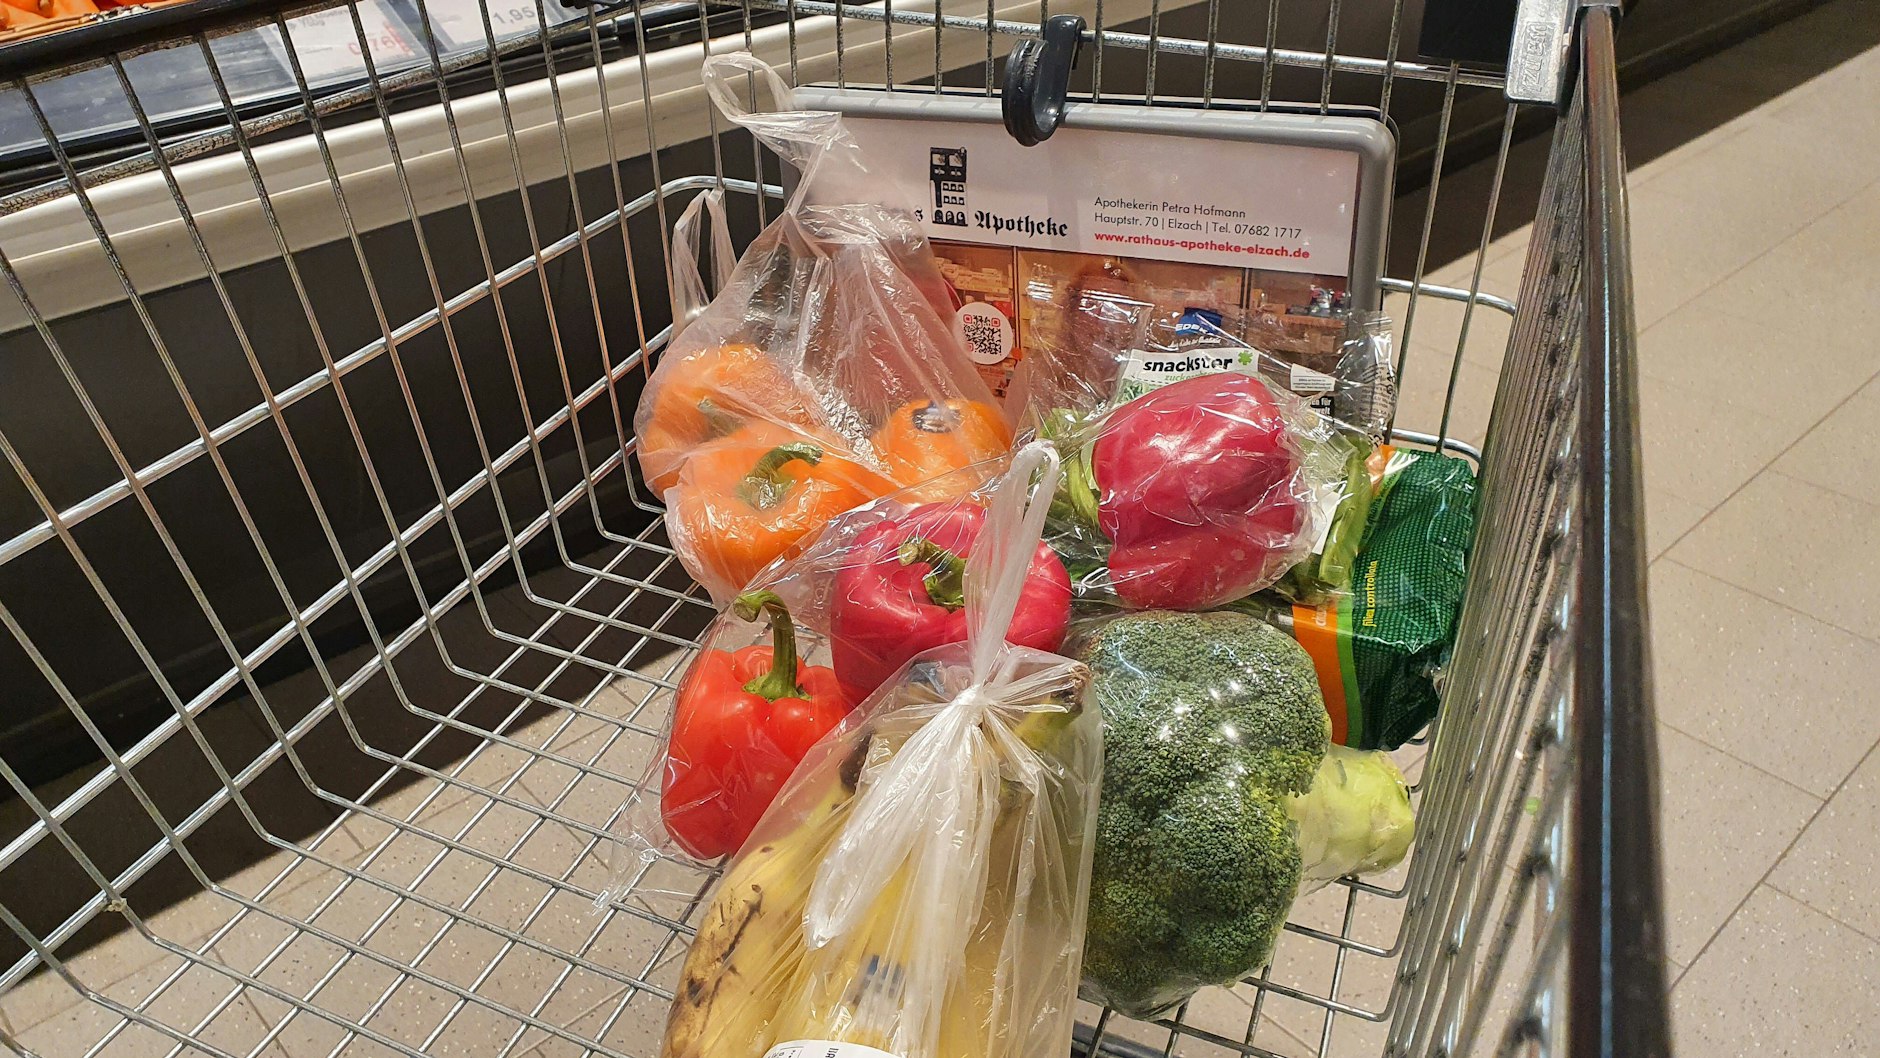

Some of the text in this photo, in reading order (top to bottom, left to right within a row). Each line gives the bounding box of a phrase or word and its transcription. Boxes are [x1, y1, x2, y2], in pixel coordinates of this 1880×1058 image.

[493, 6, 535, 24] 1,95
[1094, 197, 1246, 218] Apothekerin Petra Hofmann
[974, 210, 1068, 238] Apotheke
[1094, 212, 1142, 227] Hauptstr.
[1145, 217, 1159, 227] 70
[1168, 218, 1202, 231] Elzach
[1212, 222, 1231, 234] Tel.
[1234, 225, 1270, 237] 07682
[1274, 227, 1302, 239] 1717
[1094, 232, 1310, 259] www.rathaus-apotheke-elzach.de
